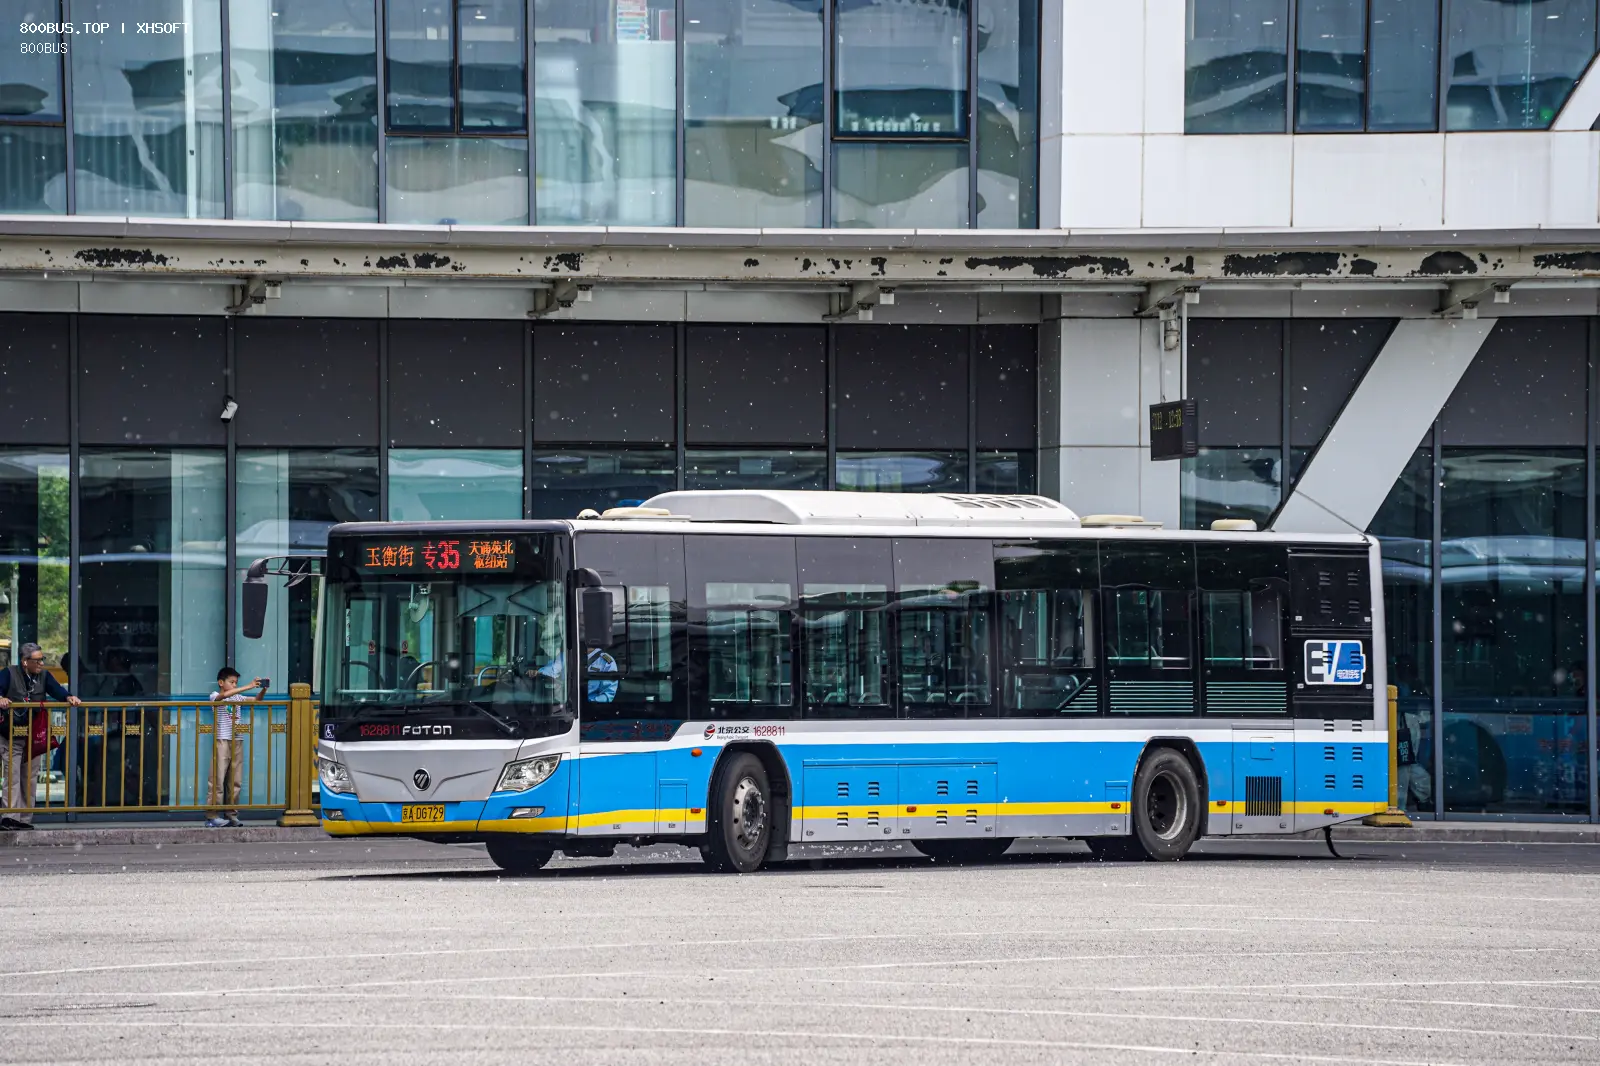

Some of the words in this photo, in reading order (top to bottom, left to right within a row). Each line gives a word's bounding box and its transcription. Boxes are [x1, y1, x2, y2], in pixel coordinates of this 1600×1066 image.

[364, 545, 415, 568] 玉衡街
[421, 540, 460, 569] 专35
[468, 539, 514, 556] 天通苑北
[473, 555, 508, 569] 枢纽站
[359, 724, 401, 736] 1628811
[402, 725, 452, 736] FOTON
[718, 726, 750, 734] 北京公交
[753, 725, 785, 737] 1628811
